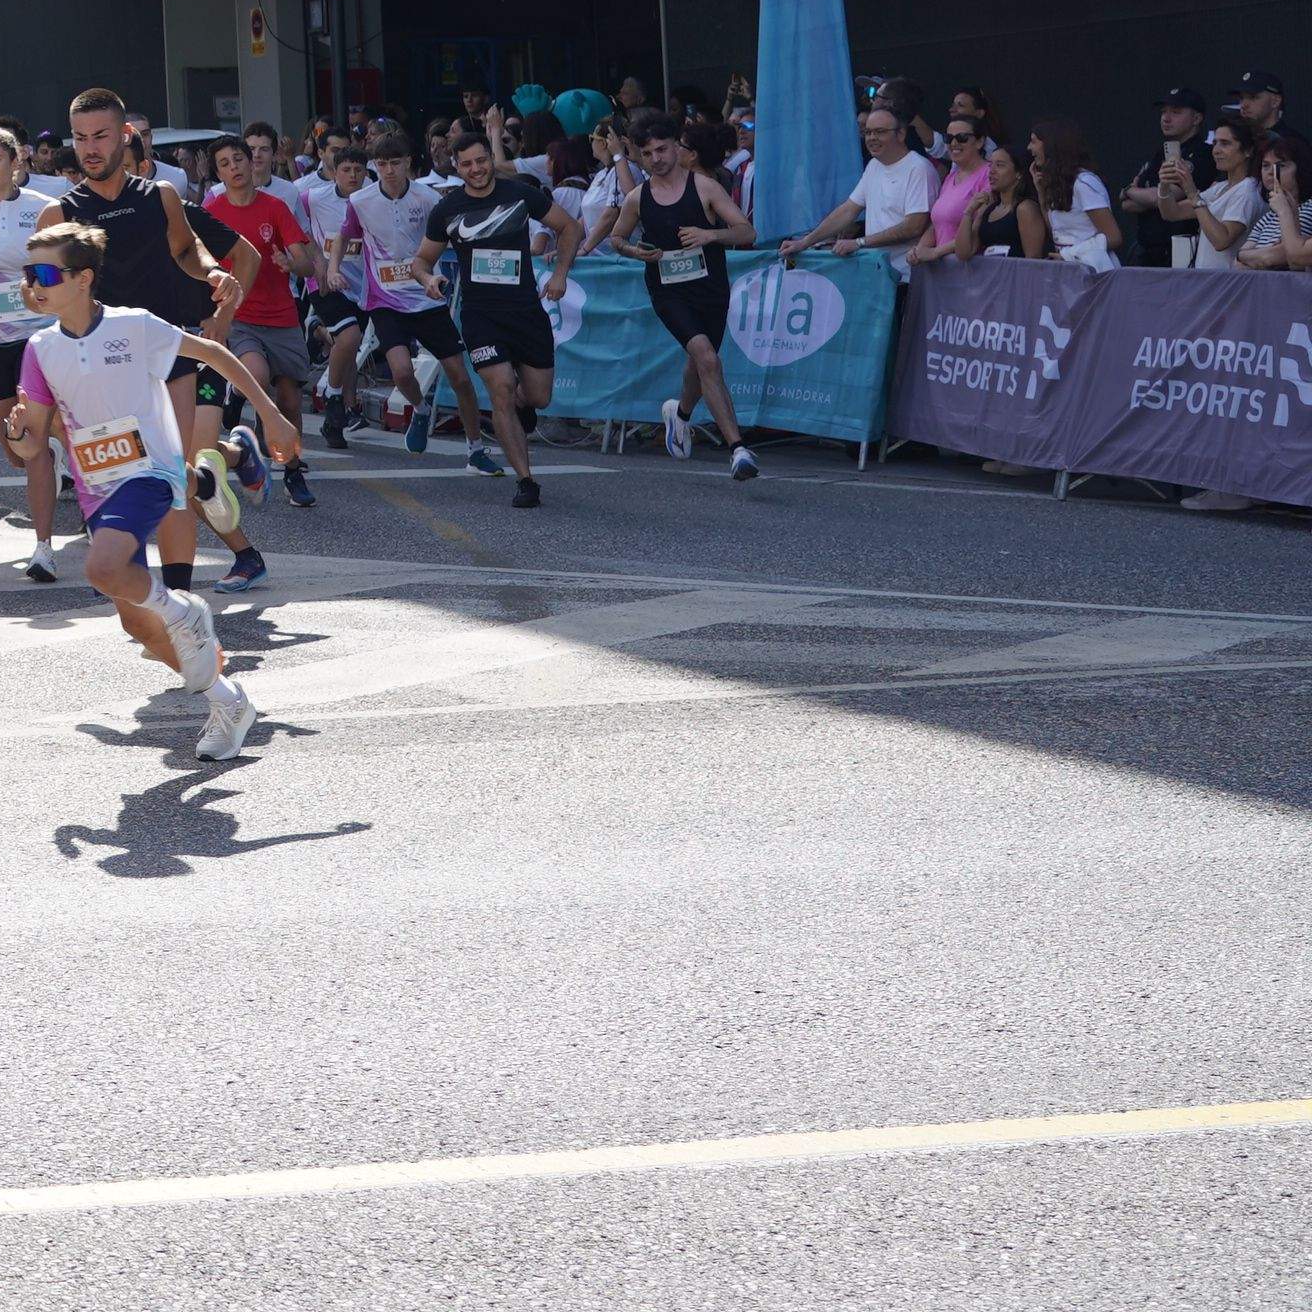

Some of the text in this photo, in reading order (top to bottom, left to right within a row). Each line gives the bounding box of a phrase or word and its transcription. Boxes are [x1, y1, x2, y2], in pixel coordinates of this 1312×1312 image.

[98, 207, 135, 220] macron
[670, 259, 693, 273] 999
[738, 266, 814, 336] illa
[924, 313, 1027, 356] ANDORRA
[104, 353, 133, 366] MOU-TE
[925, 350, 1020, 397] ESPORTS
[1132, 336, 1275, 379] ANDORRA
[1129, 378, 1267, 423] ESPORTS
[83, 438, 133, 466] 1640
